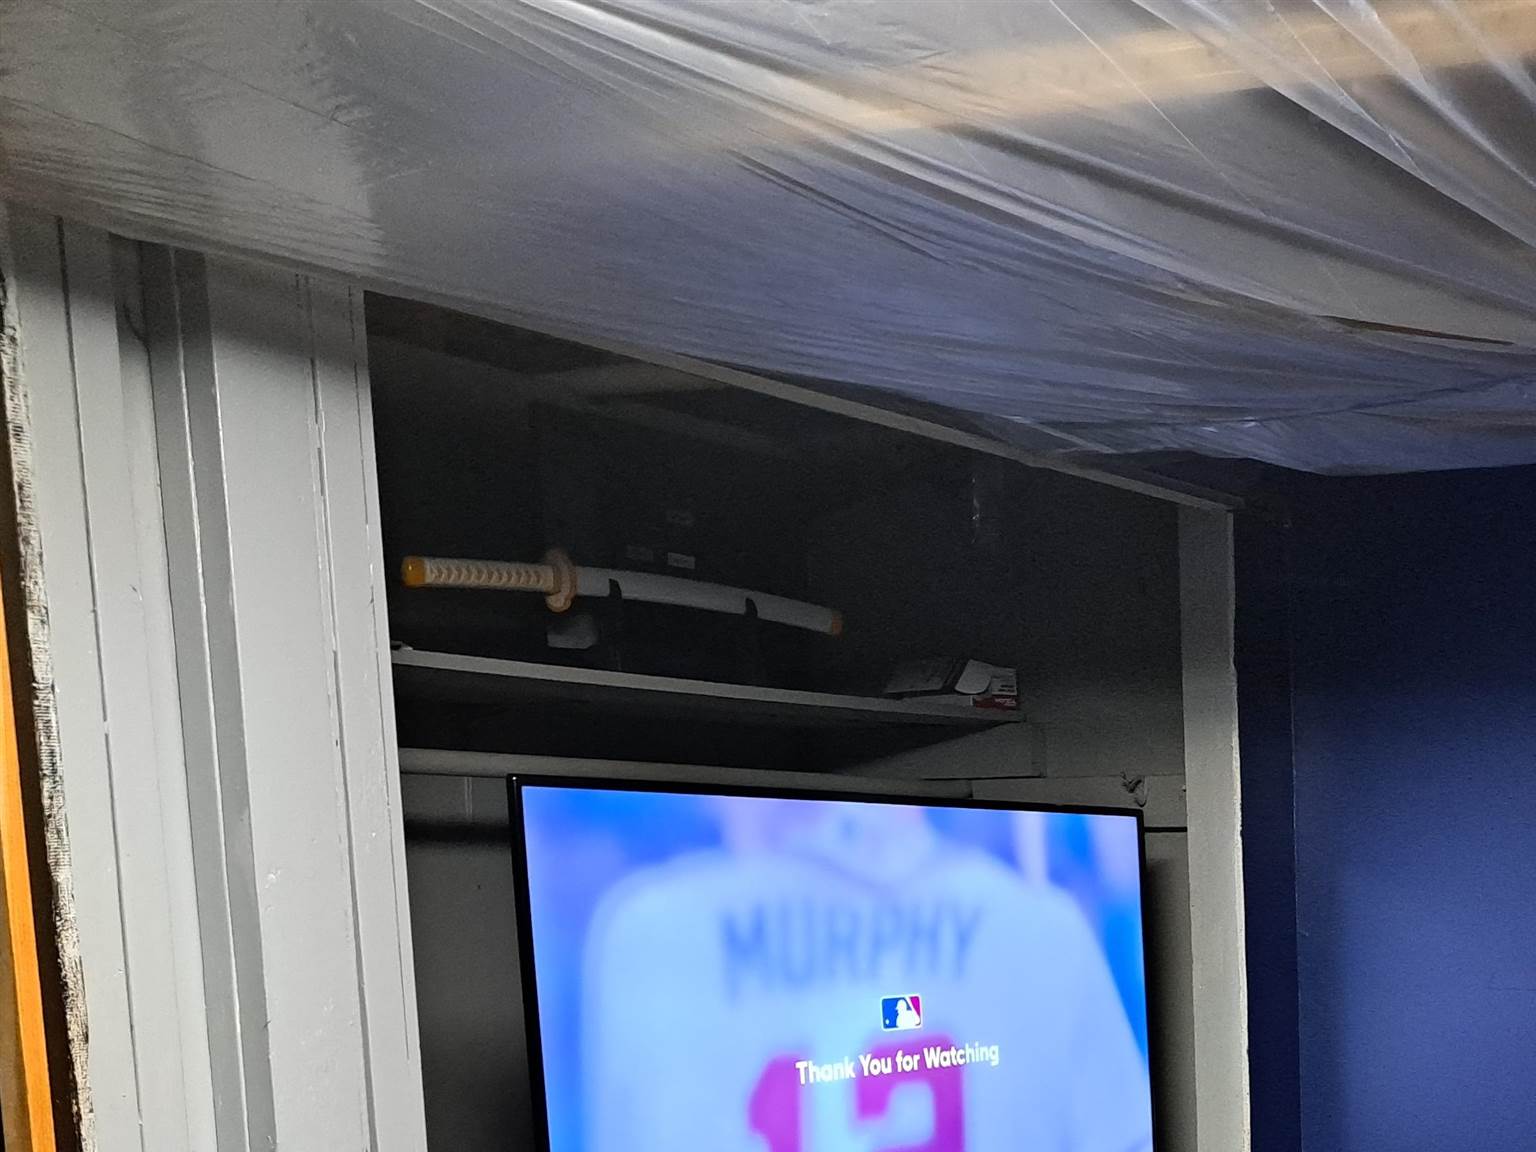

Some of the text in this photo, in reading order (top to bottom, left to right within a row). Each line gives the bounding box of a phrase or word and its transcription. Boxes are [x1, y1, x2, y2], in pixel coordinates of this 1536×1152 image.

[722, 902, 984, 998] MURPHY
[795, 1042, 1000, 1085] Thank You for Watching
